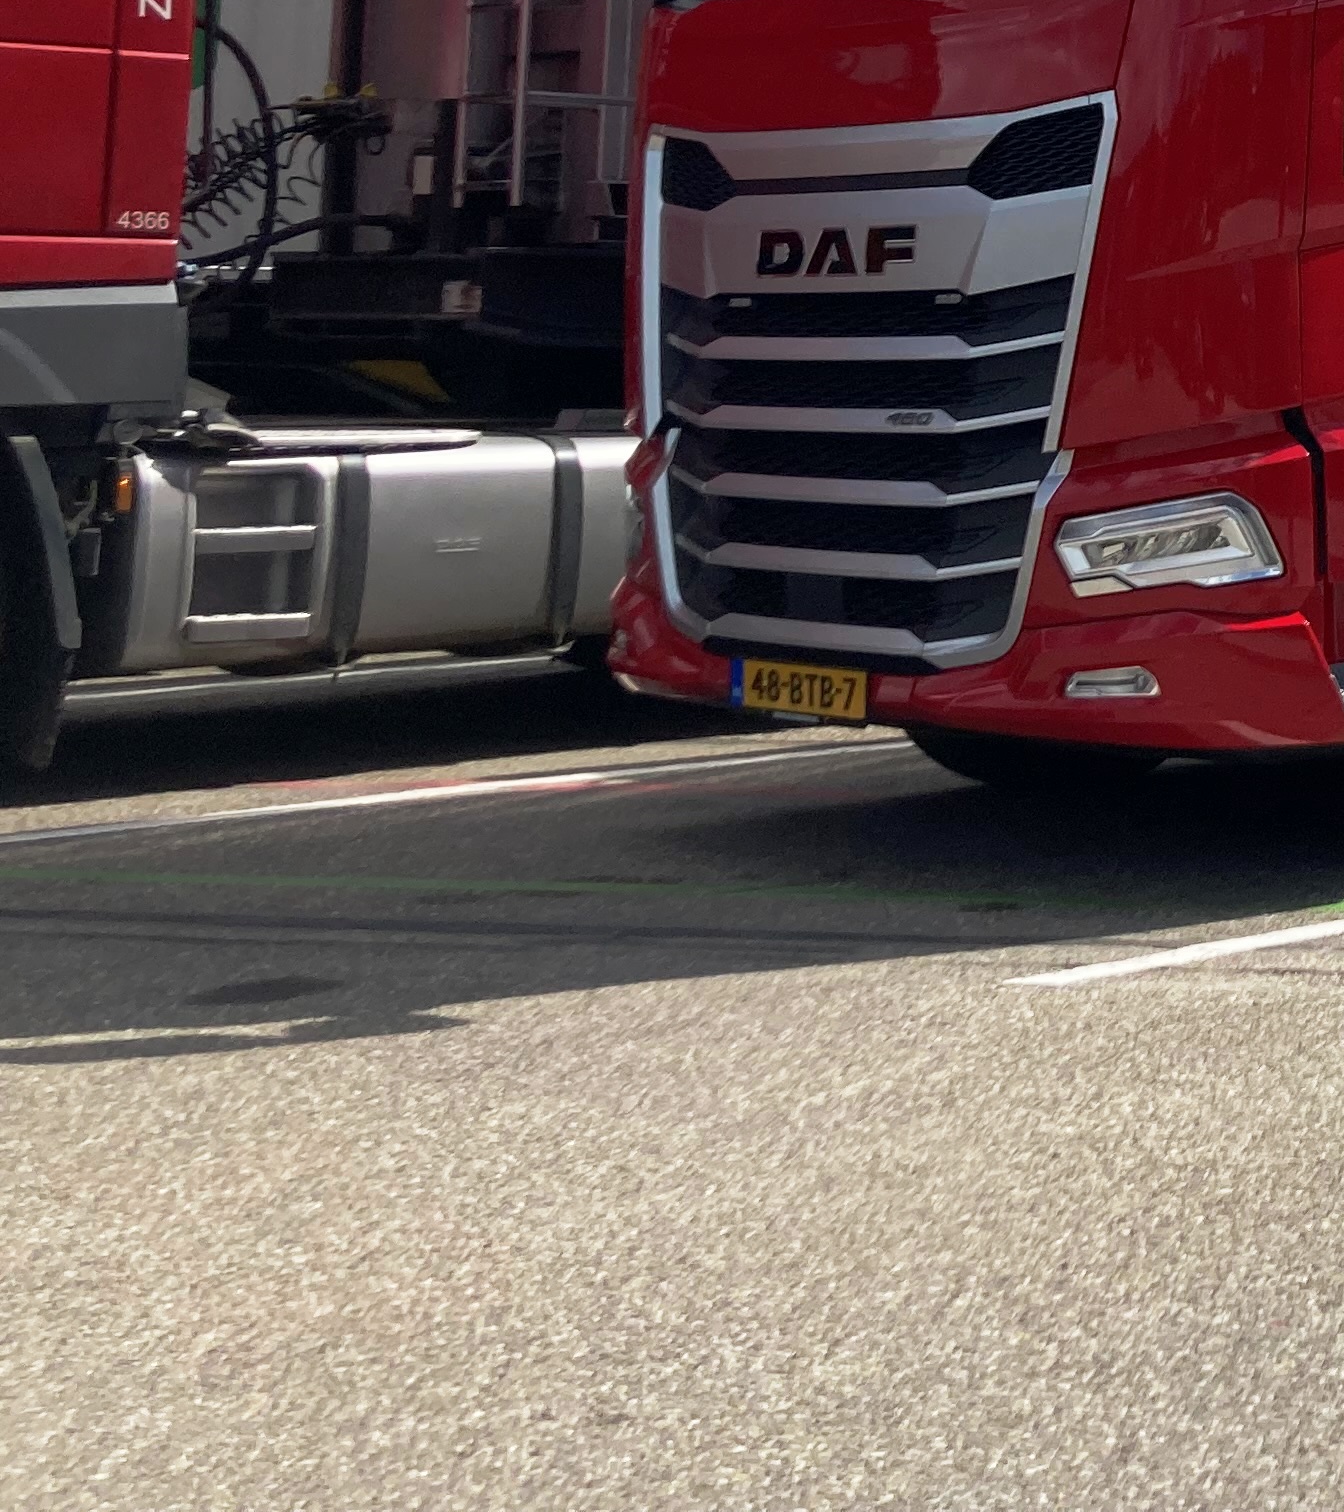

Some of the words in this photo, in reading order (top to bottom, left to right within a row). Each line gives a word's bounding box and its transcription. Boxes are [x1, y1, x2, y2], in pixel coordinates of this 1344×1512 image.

[116, 210, 170, 230] 4366
[756, 224, 919, 278] DAF
[751, 668, 857, 710] 48-BTB-7
